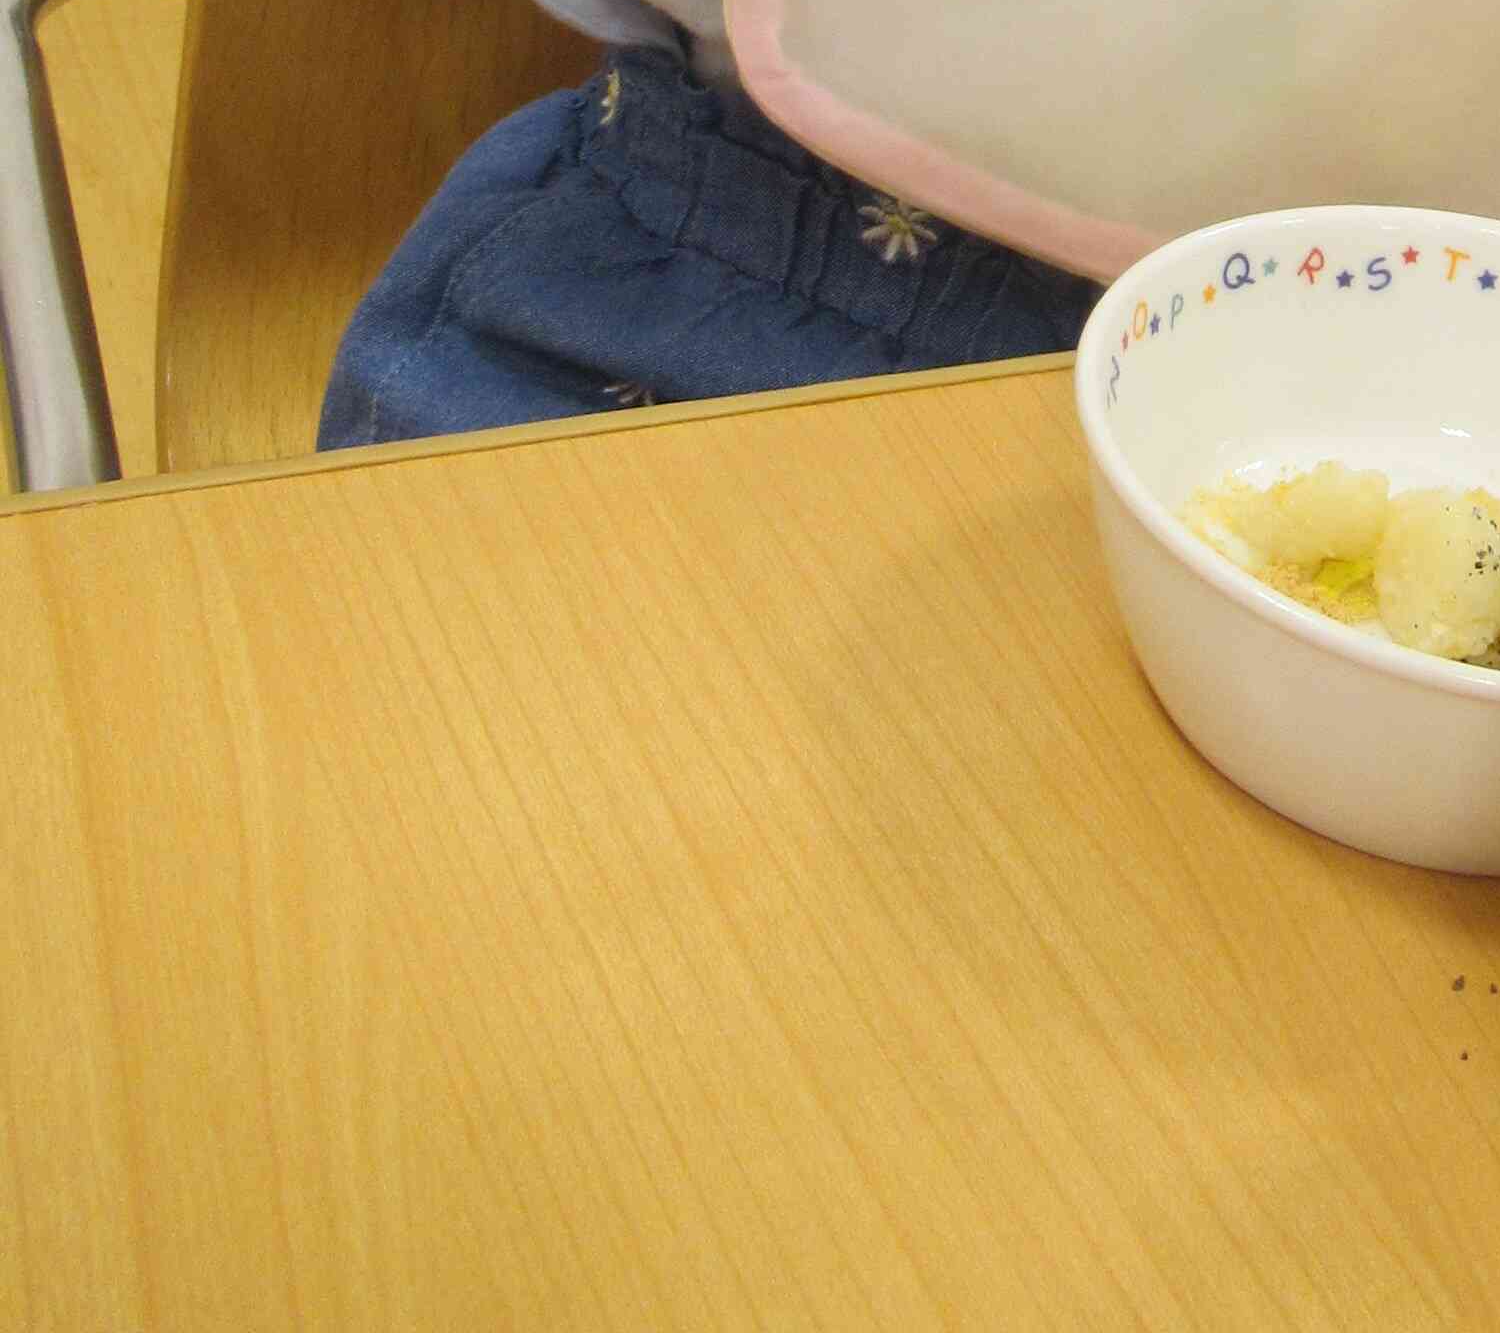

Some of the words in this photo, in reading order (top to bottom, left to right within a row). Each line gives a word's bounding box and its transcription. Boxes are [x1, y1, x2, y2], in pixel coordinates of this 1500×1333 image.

[1169, 292, 1185, 331] P
[1221, 251, 1256, 290] Q
[1296, 246, 1326, 285] R
[1365, 255, 1393, 292] S
[1443, 245, 1471, 283] T
